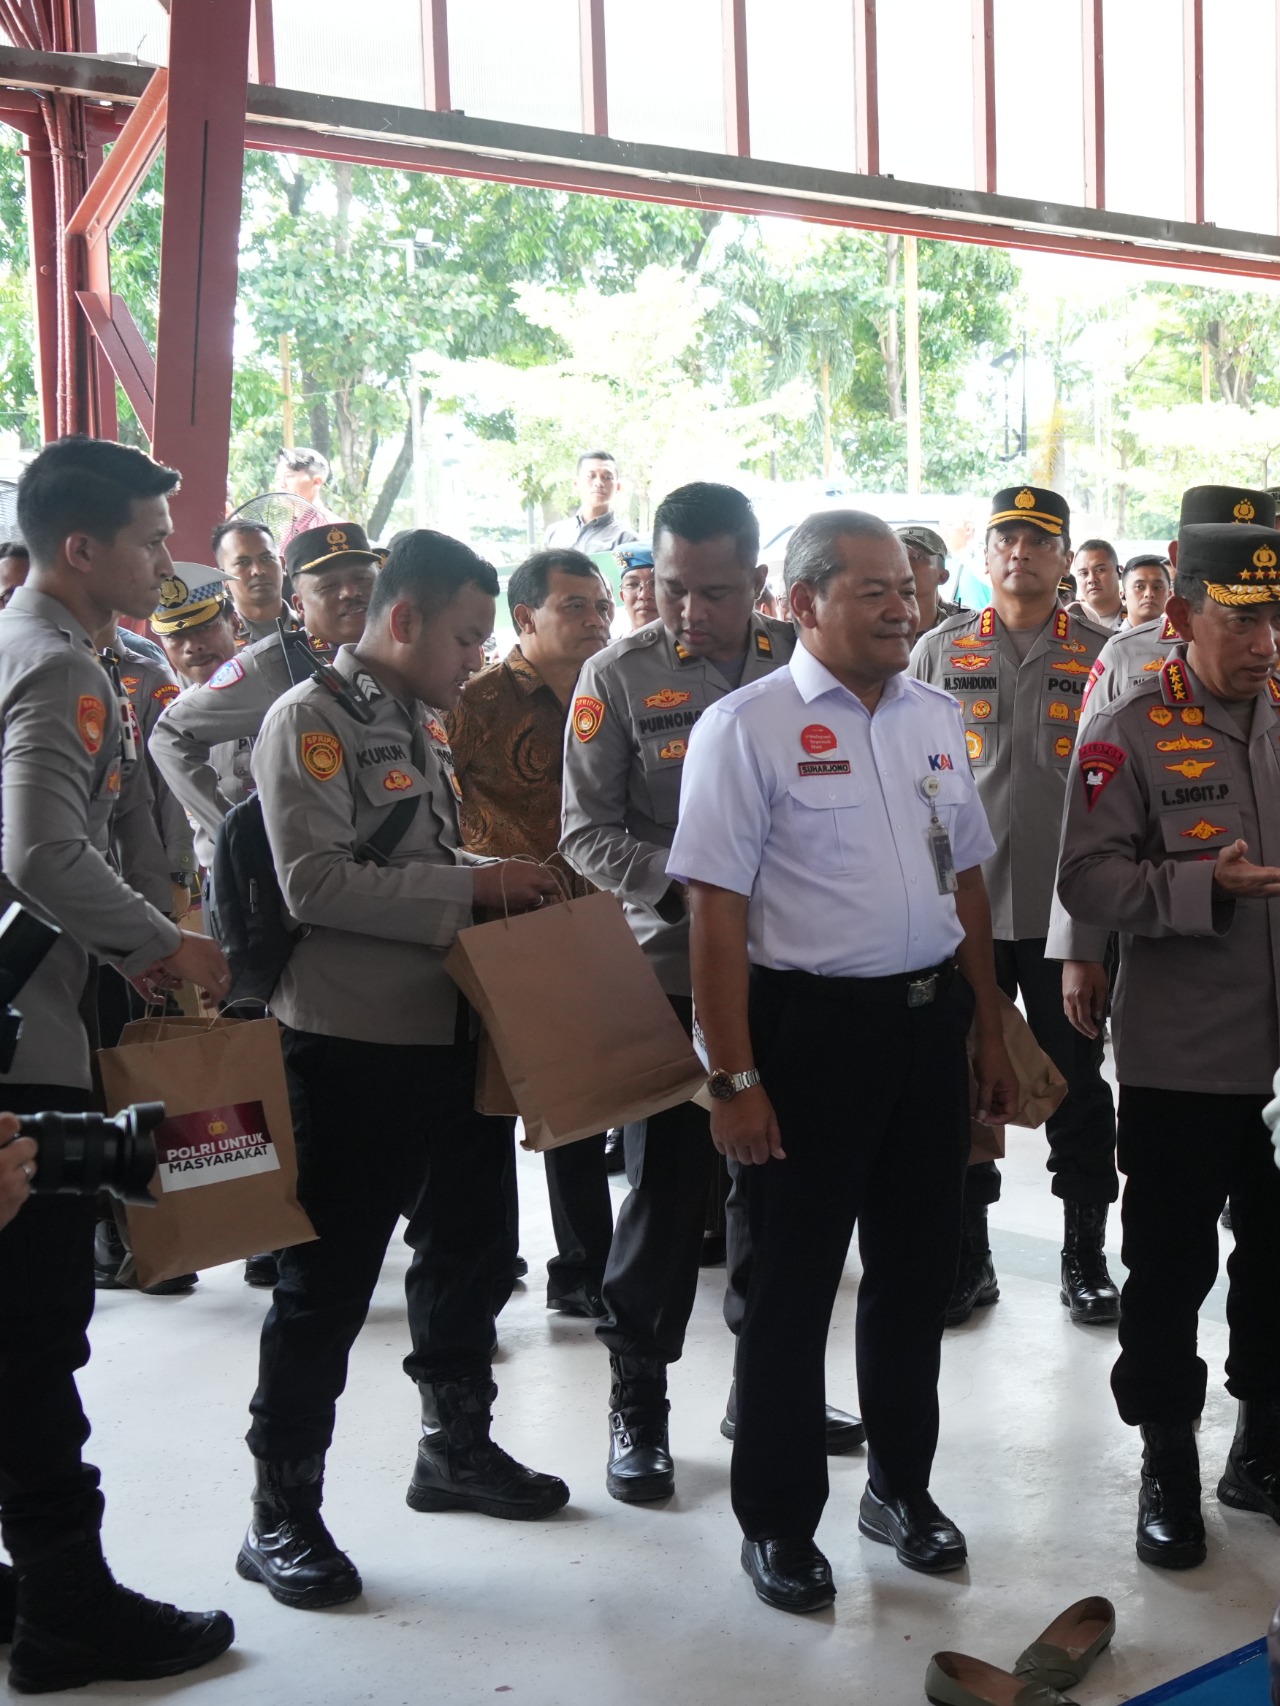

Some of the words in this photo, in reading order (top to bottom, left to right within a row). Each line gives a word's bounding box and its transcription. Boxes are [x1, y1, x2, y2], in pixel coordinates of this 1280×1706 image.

[575, 699, 602, 712] SPRIPIM
[306, 735, 340, 749] SPRIPIM
[356, 745, 407, 769] KUKUH
[928, 753, 954, 771] KAI
[801, 764, 848, 774] SUHARJONO
[1162, 784, 1229, 806] L.SIGIT.P
[167, 1142, 215, 1160] POLRI
[219, 1133, 265, 1150] UNTUK
[169, 1145, 267, 1173] MASYARAKAT
